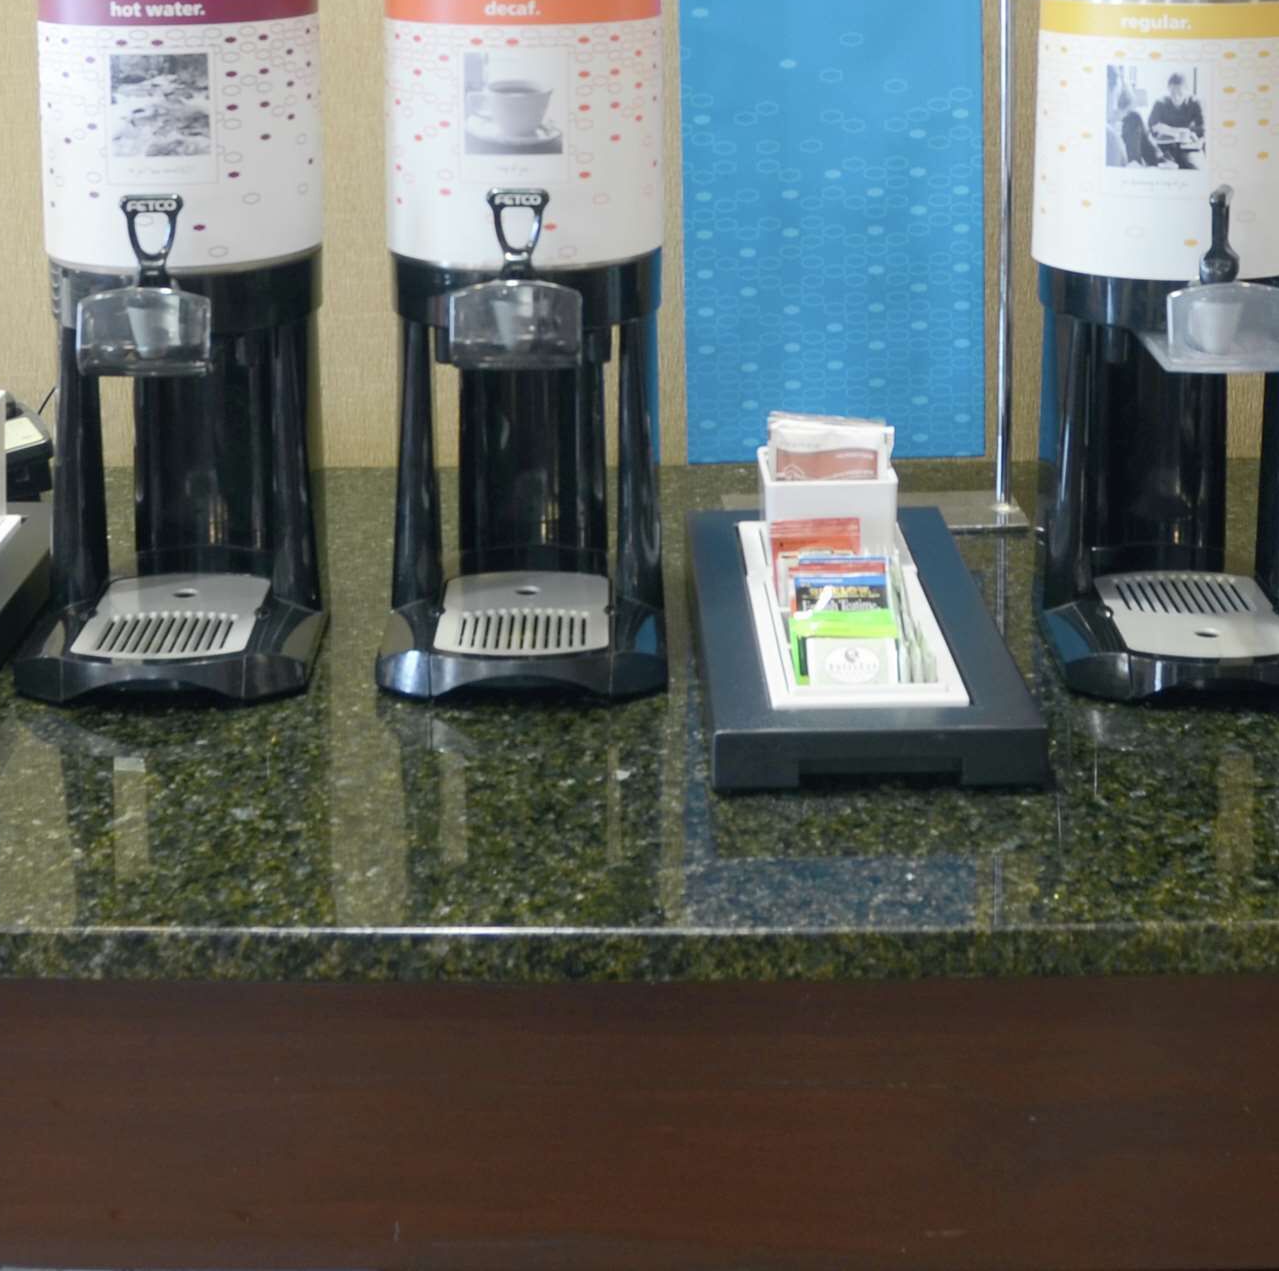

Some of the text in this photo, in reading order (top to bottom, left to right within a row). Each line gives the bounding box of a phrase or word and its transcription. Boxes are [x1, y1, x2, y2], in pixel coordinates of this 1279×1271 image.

[109, 1, 206, 17] hot water.
[484, 0, 541, 16] decaf.
[1120, 13, 1192, 32] regular.
